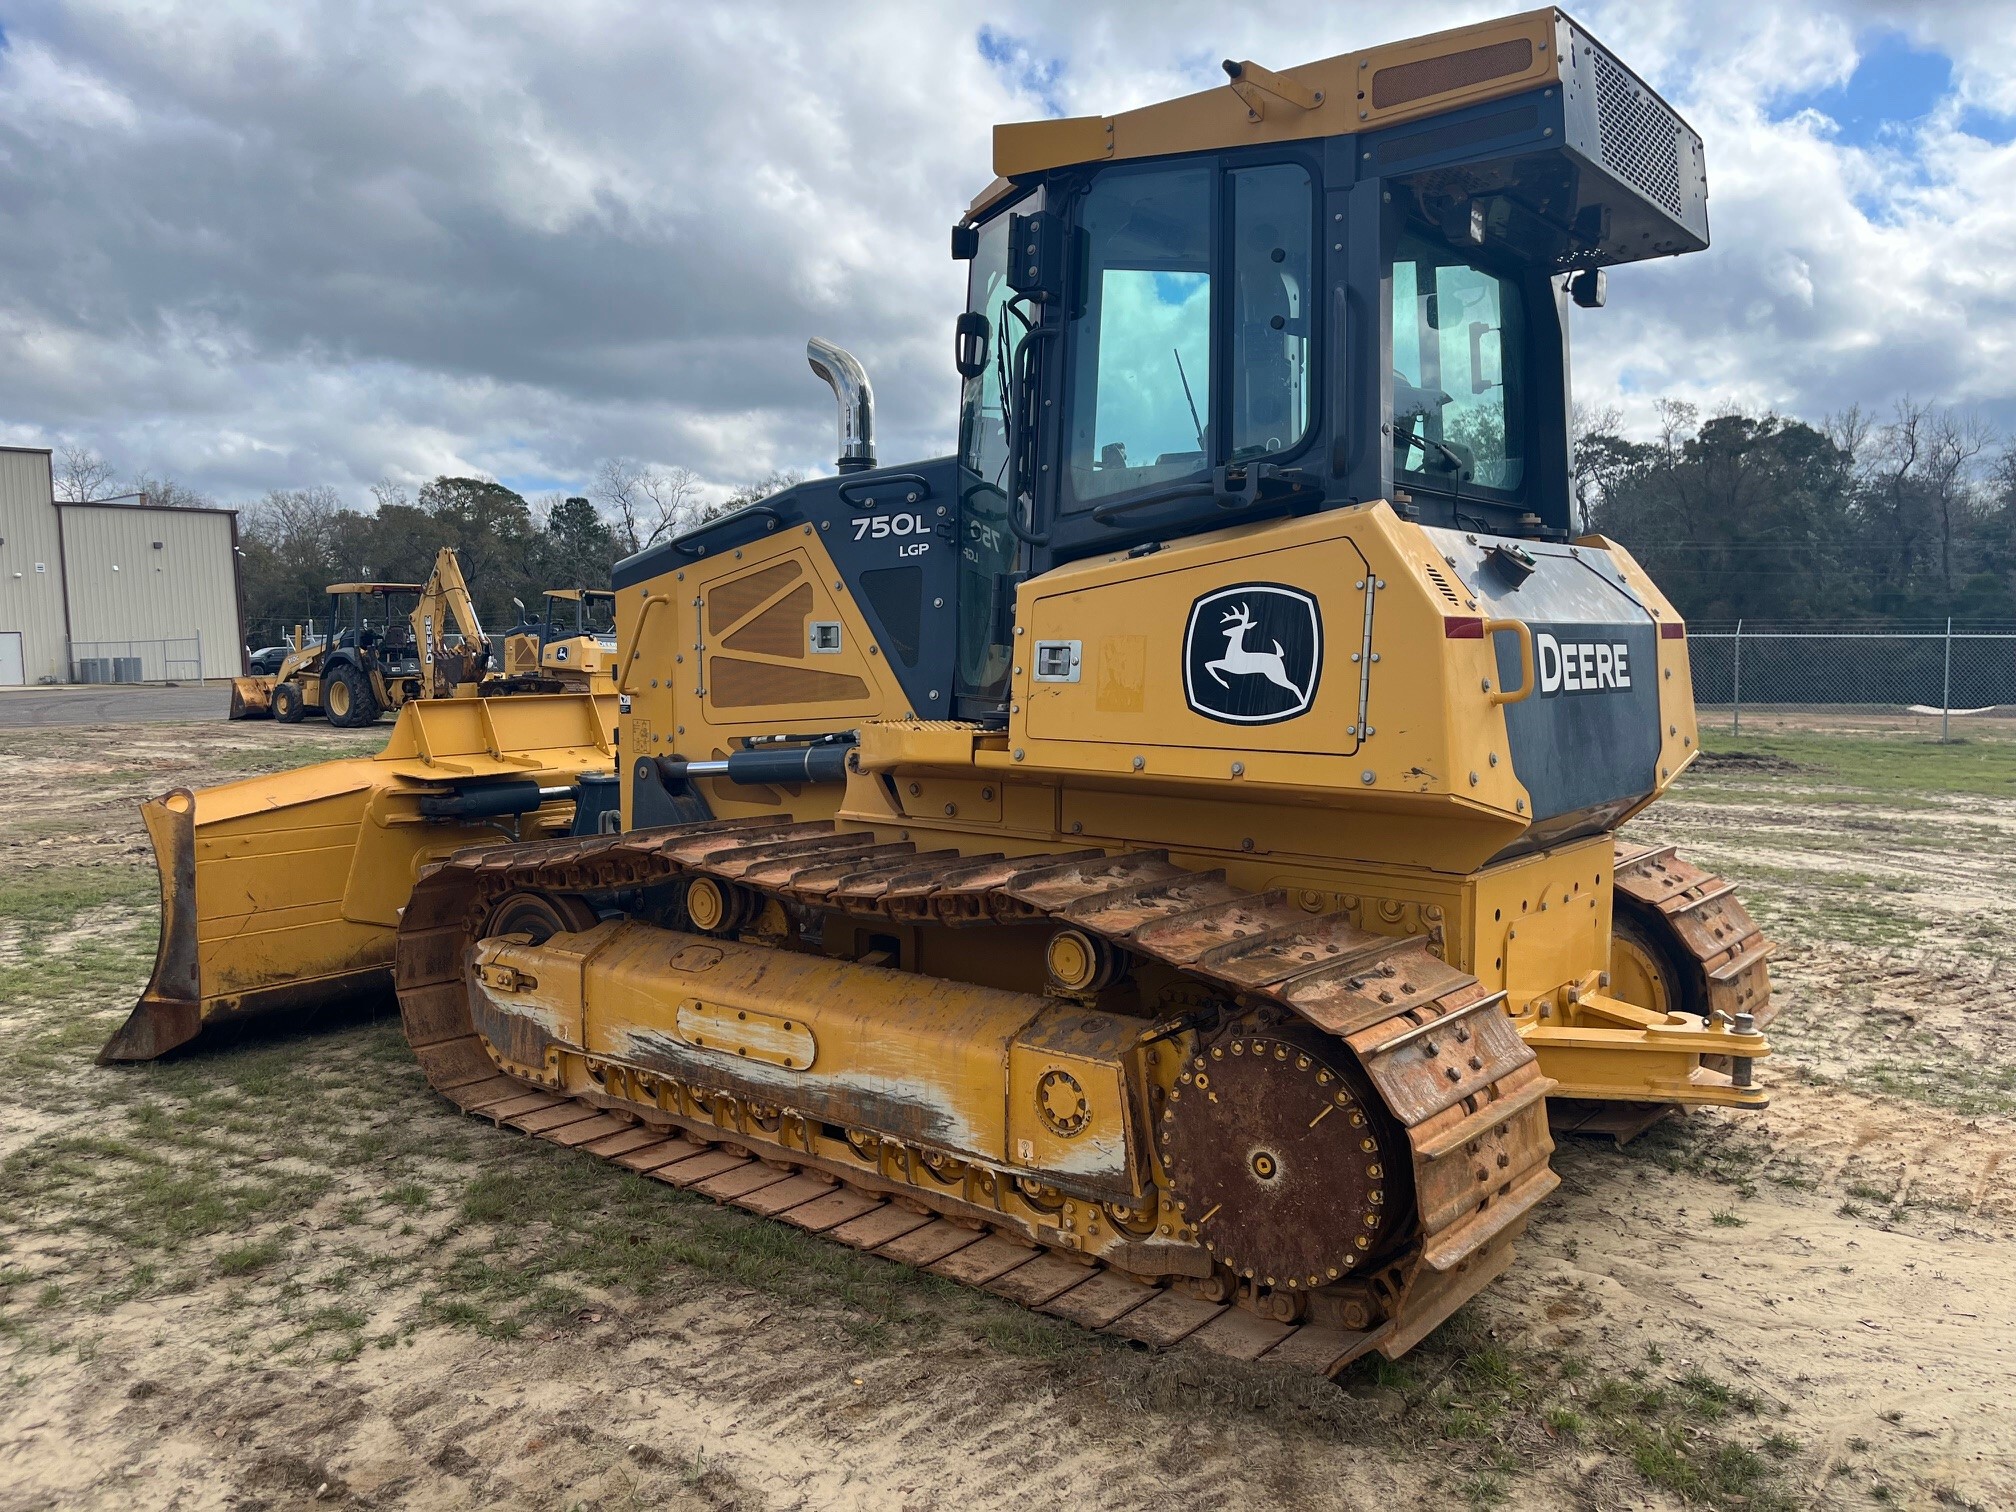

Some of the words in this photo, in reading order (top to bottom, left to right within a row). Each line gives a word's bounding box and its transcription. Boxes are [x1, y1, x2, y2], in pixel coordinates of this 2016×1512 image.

[852, 513, 931, 541] 750L
[899, 543, 930, 557] LGP
[424, 614, 433, 664] DEERE
[1537, 633, 1631, 693] DEERE
